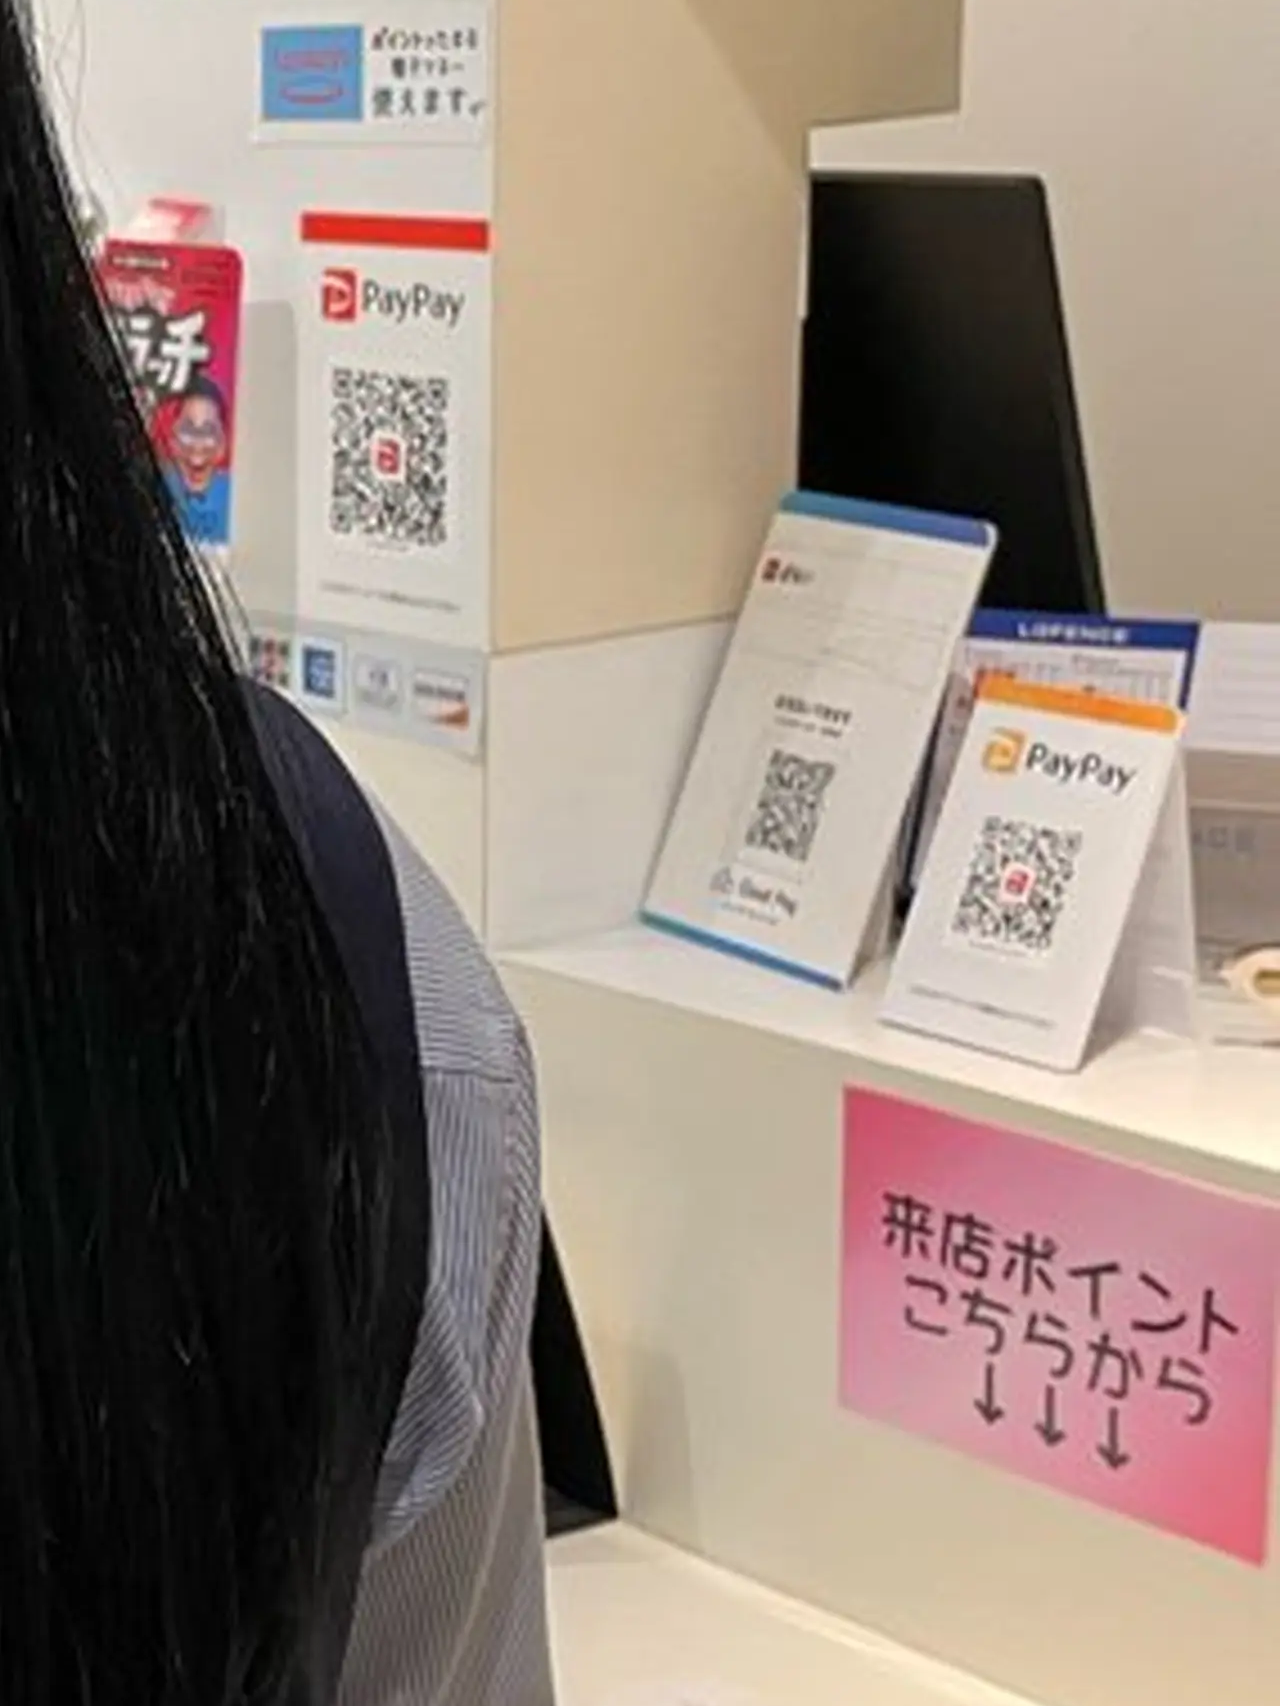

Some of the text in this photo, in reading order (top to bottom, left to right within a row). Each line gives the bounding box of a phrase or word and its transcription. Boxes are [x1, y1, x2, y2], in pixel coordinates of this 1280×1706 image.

[362, 282, 466, 328] PayPay
[118, 310, 210, 392] ラッチ
[1025, 742, 1138, 795] PayPay
[882, 1191, 1240, 1354] 来店ポイント
[904, 1274, 1214, 1426] こちらから
